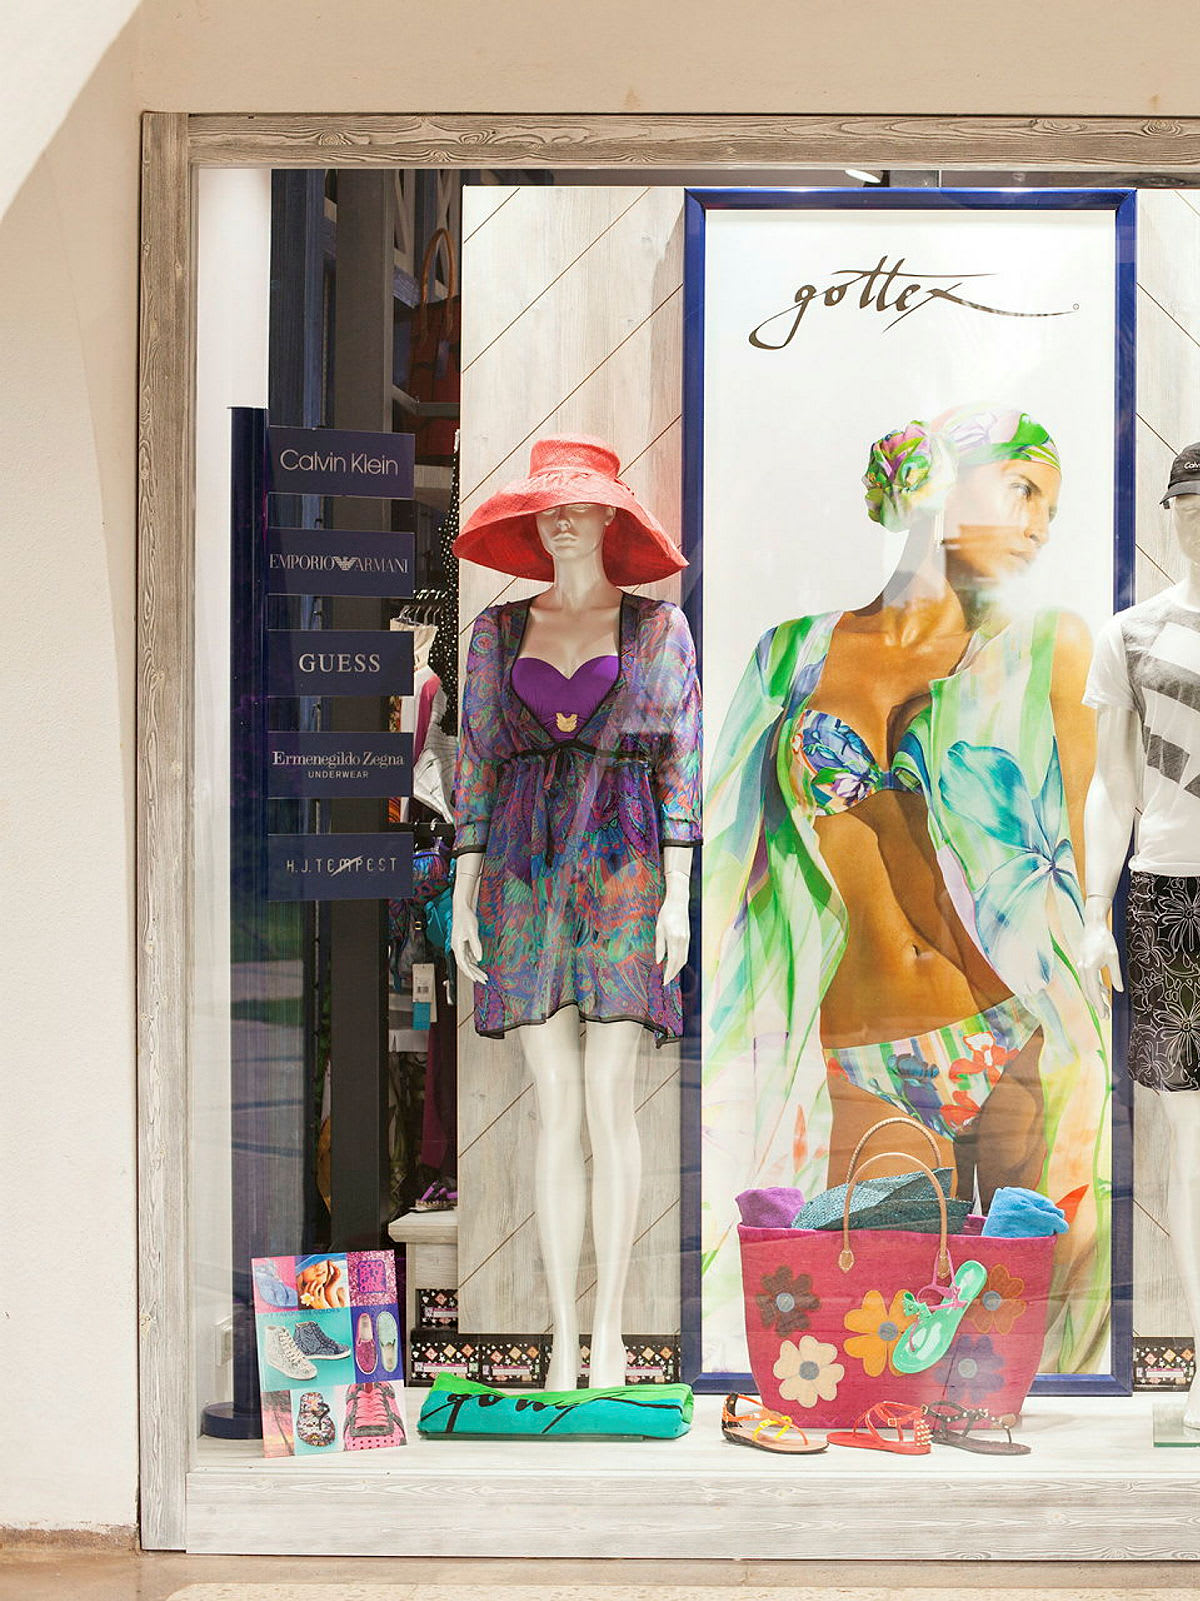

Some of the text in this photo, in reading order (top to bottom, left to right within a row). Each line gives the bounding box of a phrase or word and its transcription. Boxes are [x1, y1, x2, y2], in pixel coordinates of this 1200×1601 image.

[748, 255, 1078, 350] gottex
[280, 449, 399, 476] Calvin Klein
[269, 553, 409, 574] EMPORIO ARMANI
[298, 653, 380, 673] GUESS
[271, 751, 404, 769] Ermenegildo Zegna
[307, 770, 369, 779] UNDERWEAR
